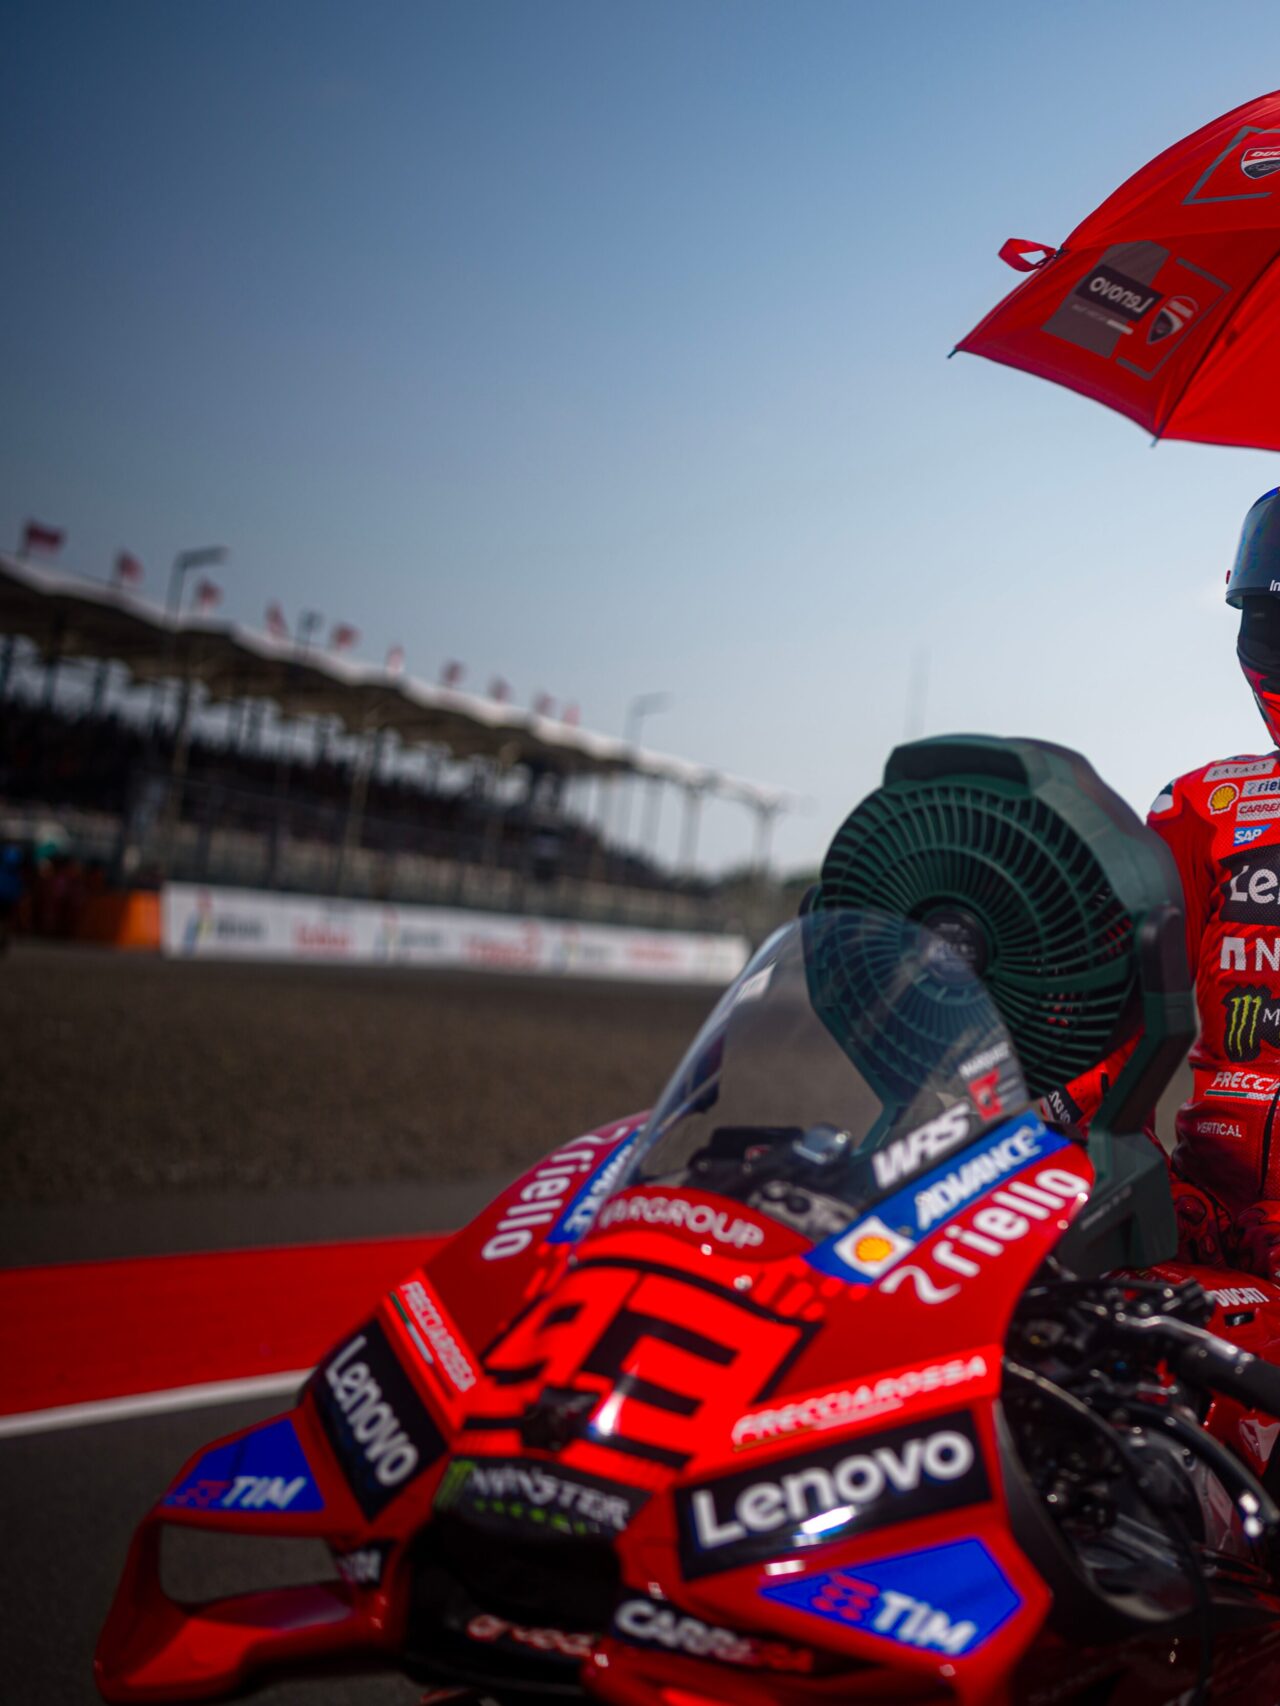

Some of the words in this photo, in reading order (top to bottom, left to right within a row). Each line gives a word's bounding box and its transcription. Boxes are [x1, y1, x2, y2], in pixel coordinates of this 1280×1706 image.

[1234, 829, 1263, 844] SAP
[871, 1101, 971, 1190] WRS
[914, 1125, 1043, 1231] ADVANCE
[480, 1148, 595, 1261] riello
[931, 1167, 1092, 1278] riello
[1212, 1287, 1270, 1308] DUCATI
[325, 1335, 418, 1487] Lenovo
[221, 1475, 307, 1510] TIM
[692, 1429, 975, 1549] Lenovo
[872, 1588, 977, 1656] TIM
